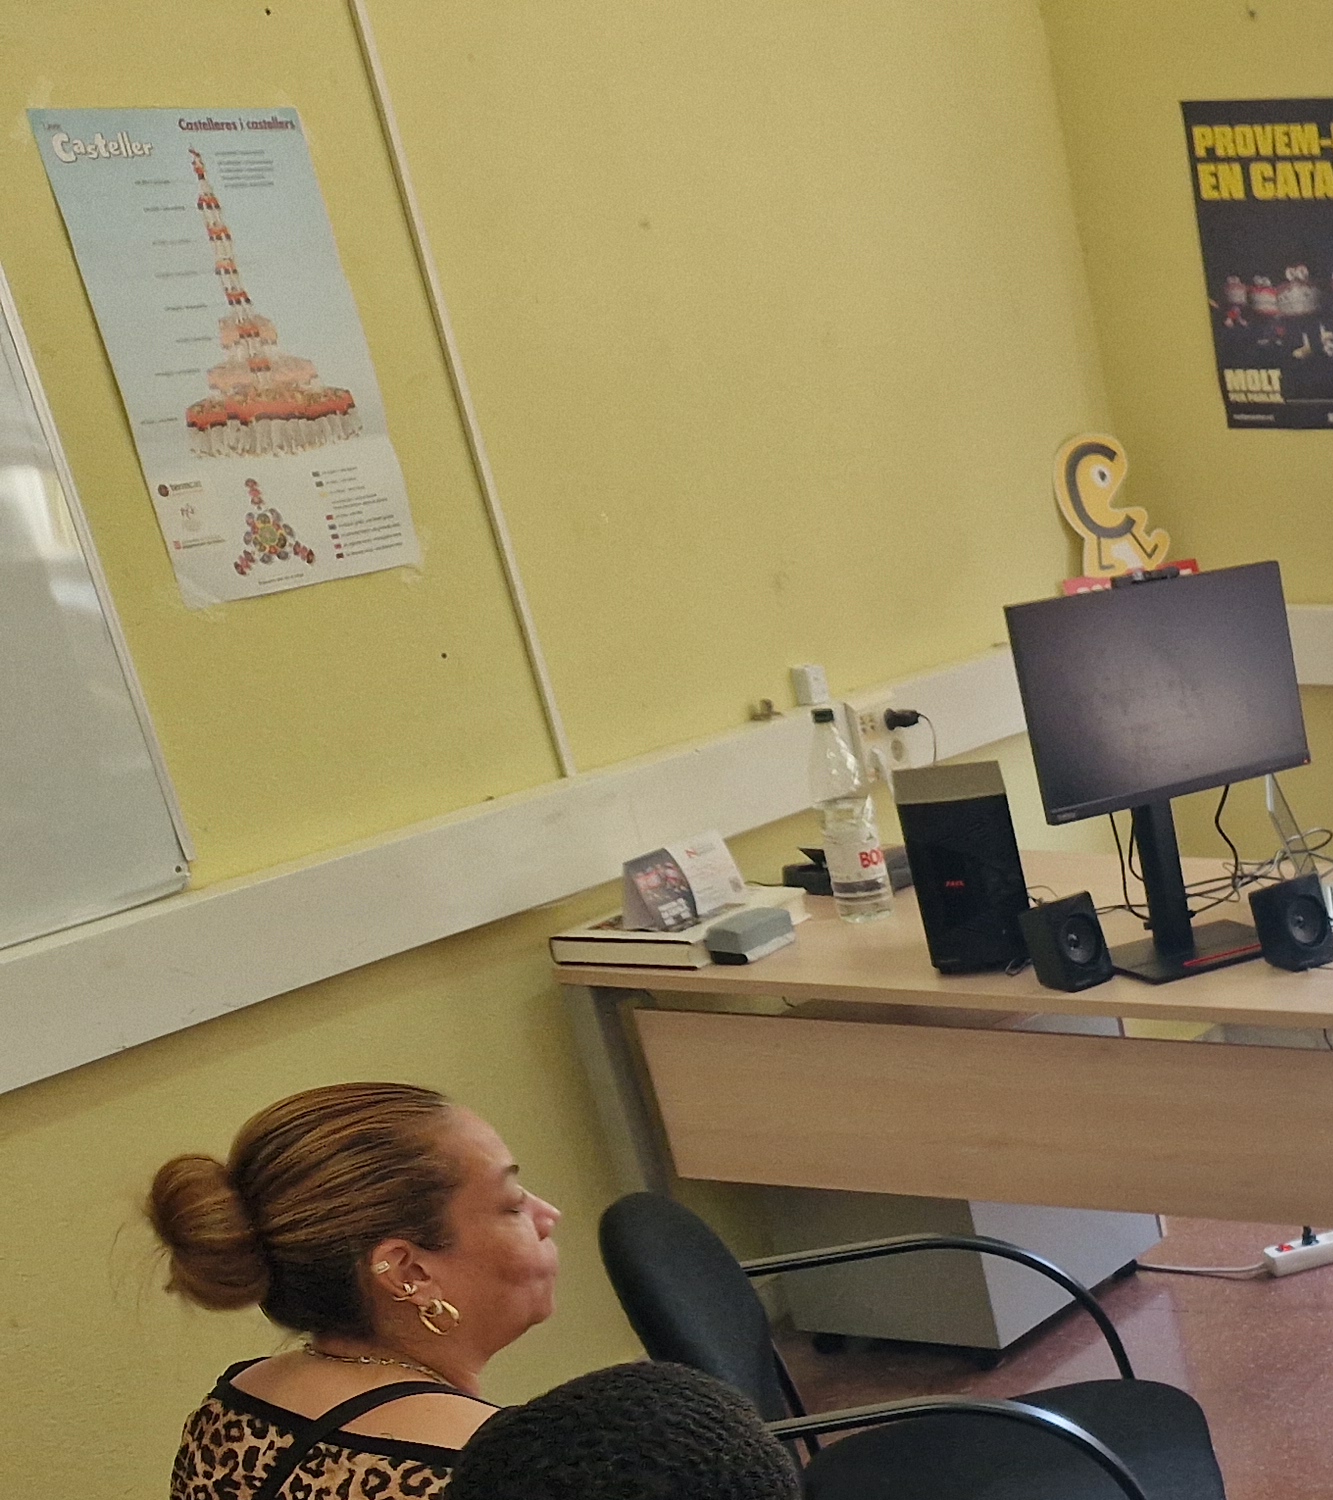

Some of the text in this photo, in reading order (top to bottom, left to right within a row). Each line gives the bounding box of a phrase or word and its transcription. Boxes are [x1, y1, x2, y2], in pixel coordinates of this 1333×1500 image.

[51, 131, 153, 164] Casteller
[1198, 163, 1245, 200] EN
[1223, 368, 1282, 391] MOLT
